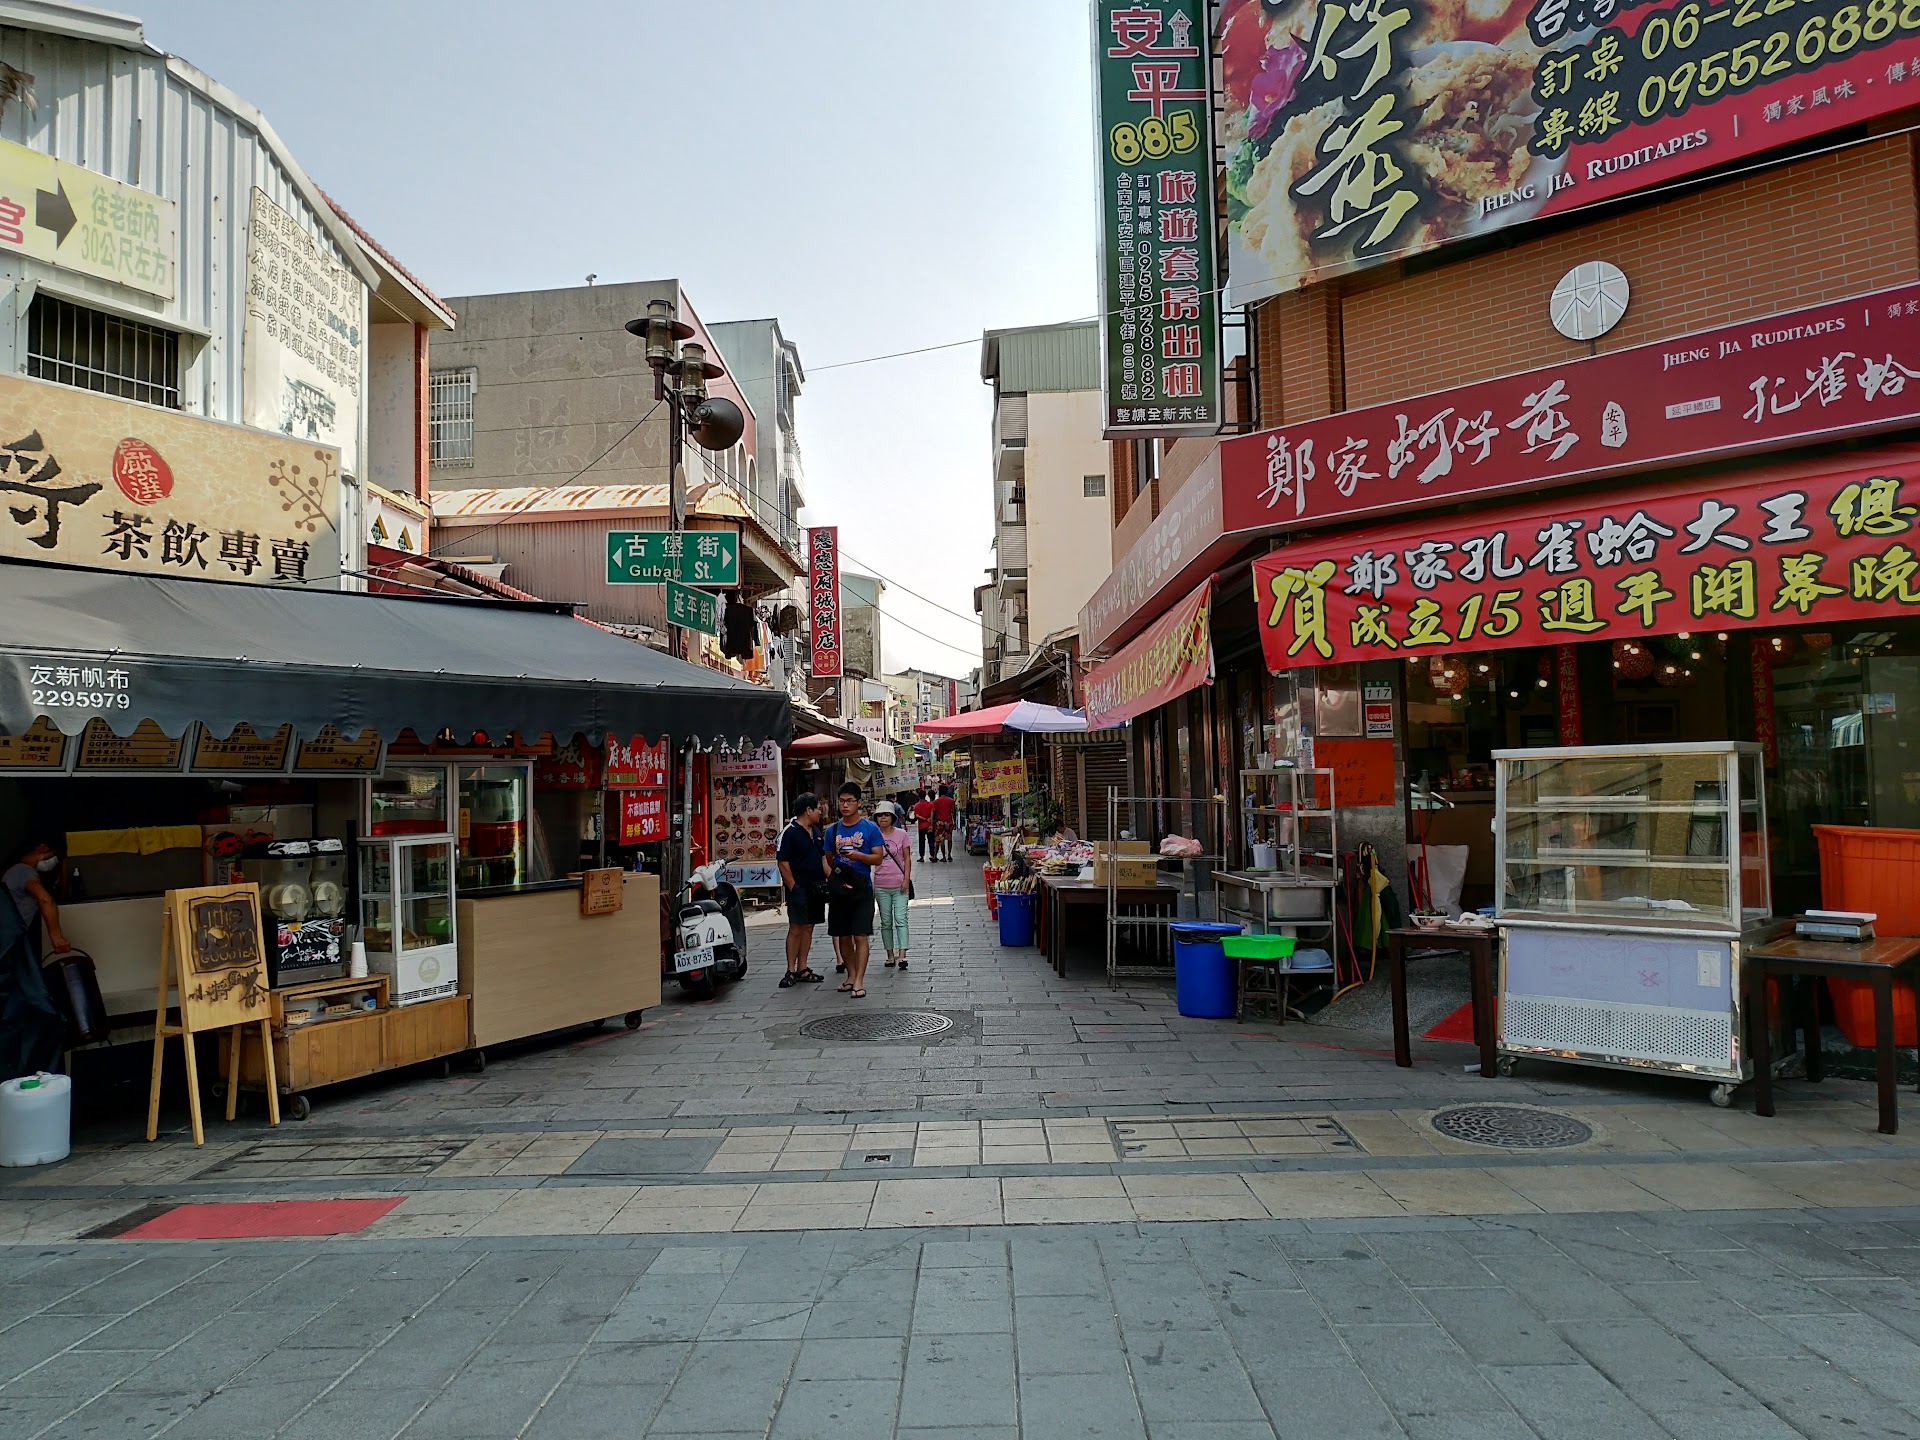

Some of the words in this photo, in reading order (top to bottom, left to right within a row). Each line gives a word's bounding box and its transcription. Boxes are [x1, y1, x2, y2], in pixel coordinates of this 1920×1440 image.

[1108, 6, 1207, 121] 安平
[1540, 35, 1624, 98] 訂桌
[1110, 109, 1200, 166] 885
[1535, 90, 1622, 150] 專線
[91, 184, 160, 243] 往老街內
[1136, 174, 1153, 235] 訂房專線
[81, 223, 168, 286] 30公尺左方
[1157, 170, 1203, 398] 旅遊套房出租
[1116, 406, 1208, 423] 整棟全新未住
[1742, 351, 1920, 424] 孔雀蛤
[1256, 379, 1579, 517] 鄭家蚵仔煎
[1604, 409, 1621, 442] 安平
[101, 510, 311, 584] 茶飲專賣
[625, 534, 720, 558] 古堡街
[629, 564, 682, 578] Gubao
[694, 560, 714, 580] St.
[673, 589, 710, 626] 延平街
[1268, 561, 1337, 659] 賀
[29, 665, 130, 689] 友新帆布
[31, 690, 130, 710] 2295979
[1367, 688, 1391, 698] 117
